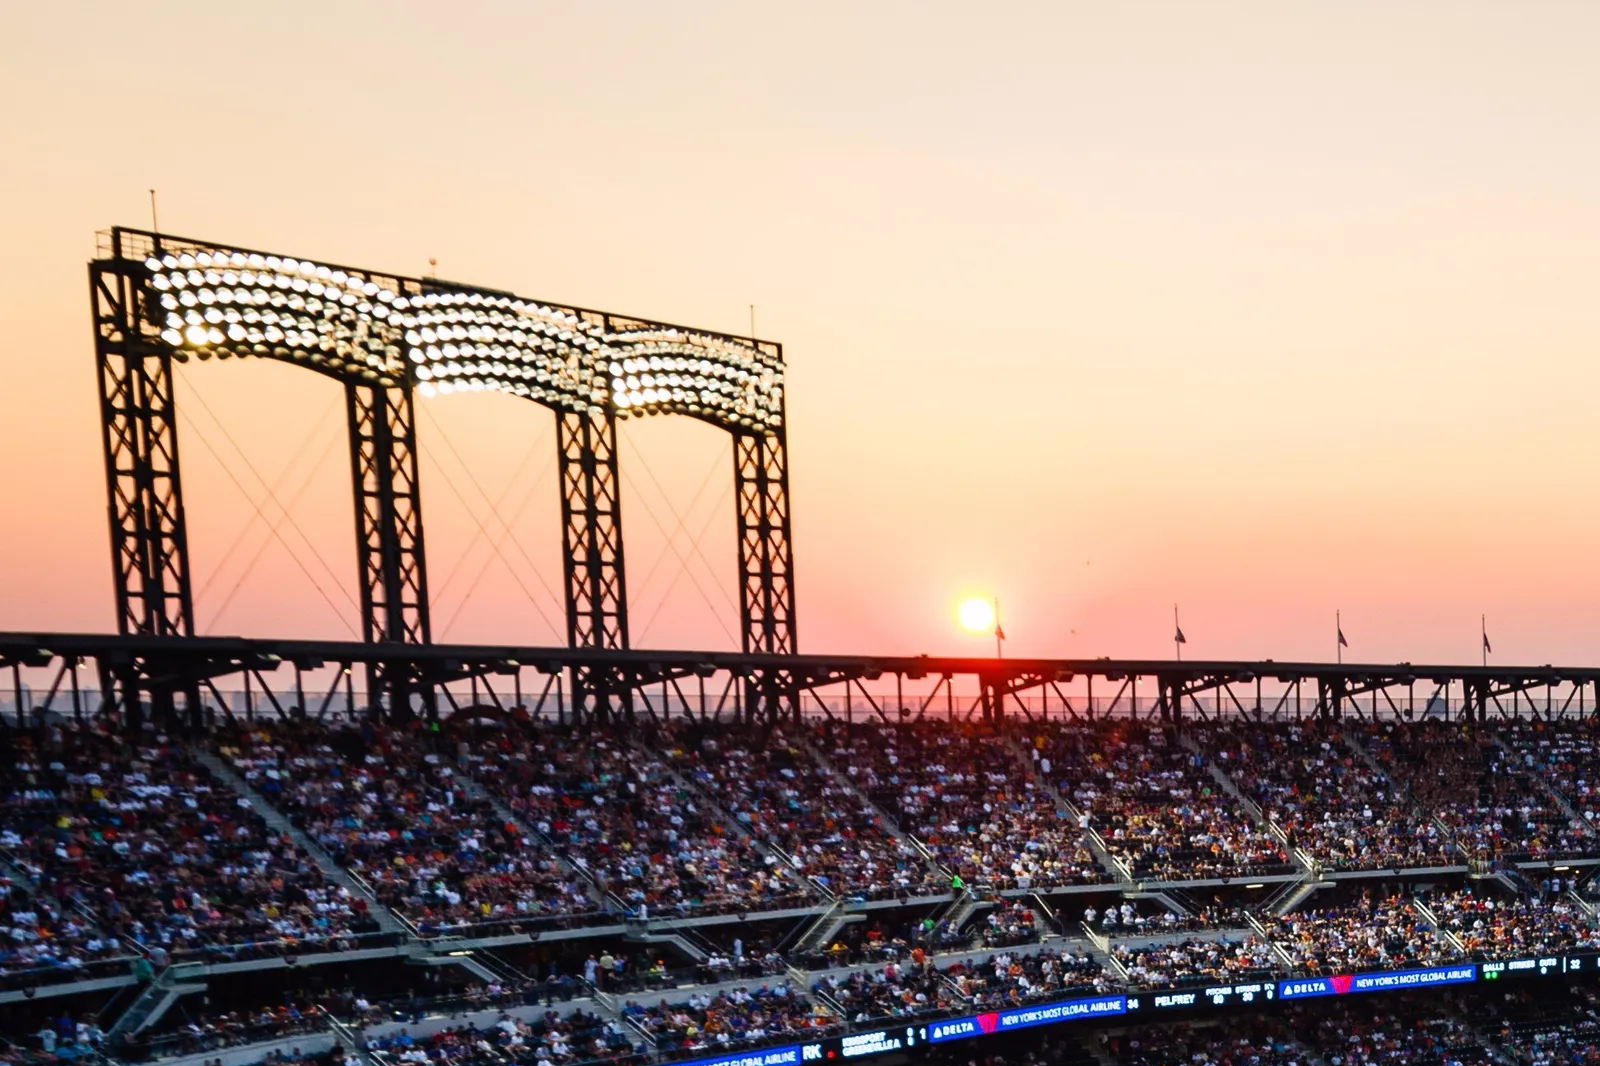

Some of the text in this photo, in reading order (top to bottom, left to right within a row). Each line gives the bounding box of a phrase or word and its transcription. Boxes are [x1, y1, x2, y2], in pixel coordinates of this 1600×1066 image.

[1483, 963, 1504, 972] BALLS
[1357, 970, 1472, 988] NEW YORK'S MOST GLOBAL AIRLINE
[1294, 983, 1325, 993] DELTA
[1155, 994, 1195, 1006] PELFREY
[1002, 1001, 1121, 1025] NEW YORK'S MOST GLOBAL AIRLINE
[920, 1028, 926, 1039] 1
[943, 1022, 974, 1036] DELTA
[764, 1051, 796, 1065] AIRLINE
[803, 1044, 822, 1060] RK
